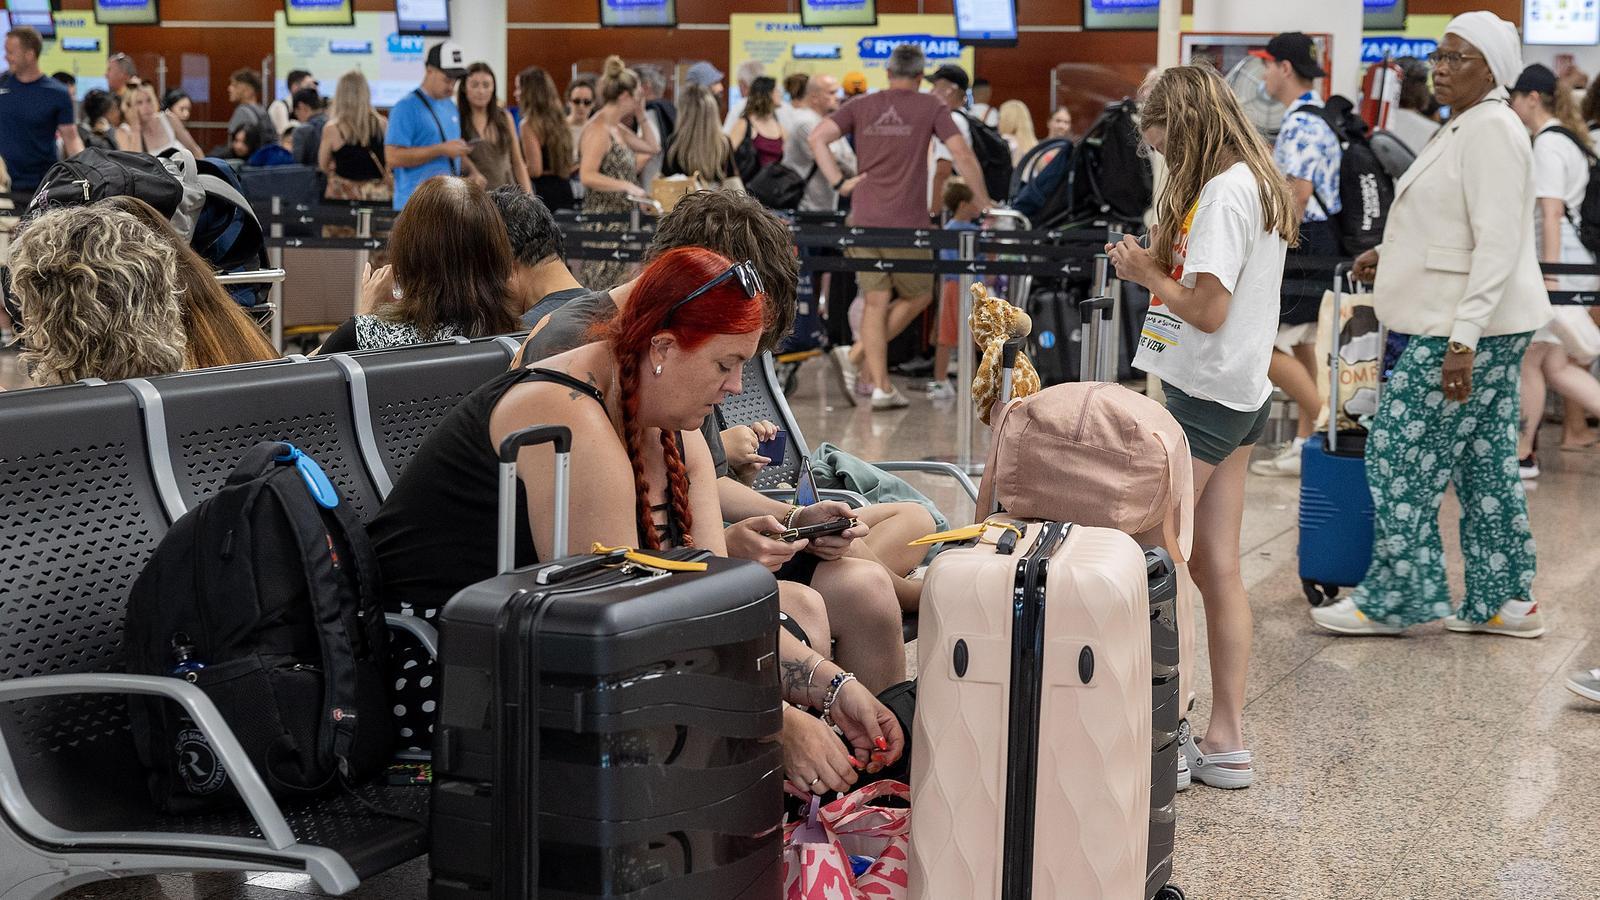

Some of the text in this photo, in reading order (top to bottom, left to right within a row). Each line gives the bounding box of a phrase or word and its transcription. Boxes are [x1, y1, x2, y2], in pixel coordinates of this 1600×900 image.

[874, 40, 960, 55] RYAIR
[1360, 42, 1437, 59] YANAIR
[1147, 339, 1167, 353] VIEW
